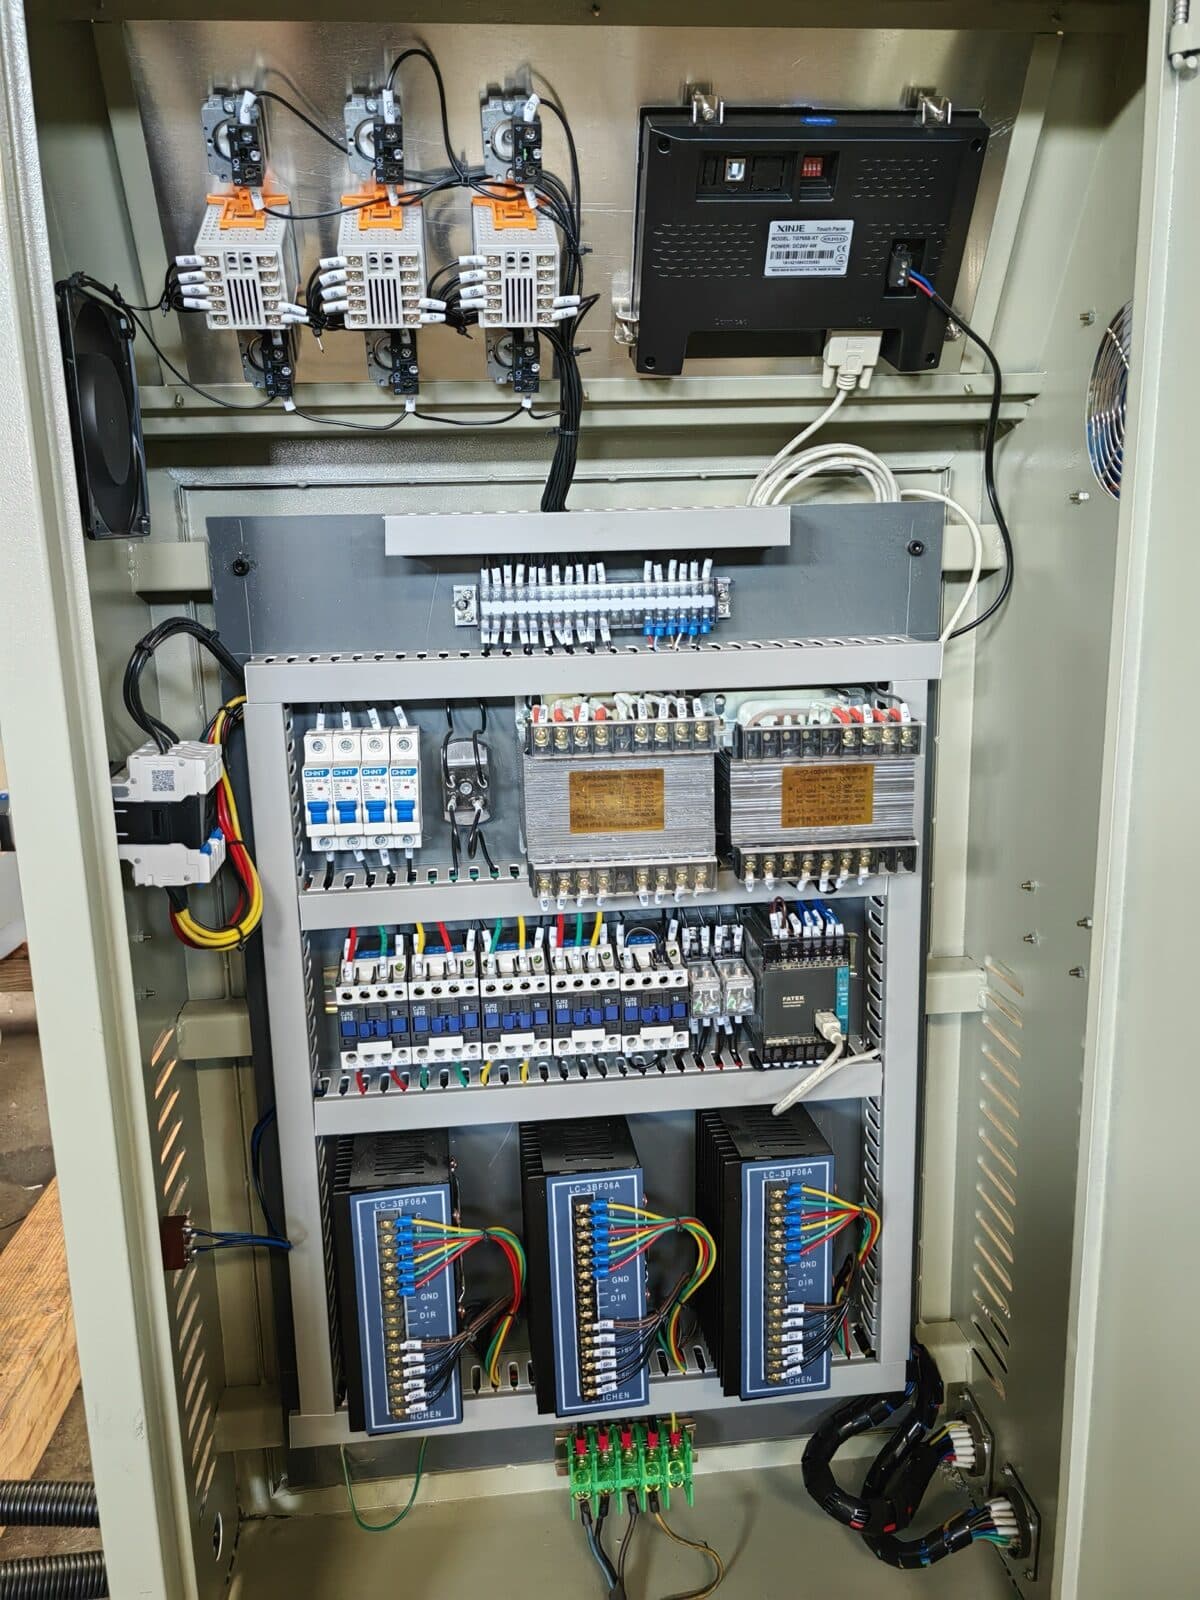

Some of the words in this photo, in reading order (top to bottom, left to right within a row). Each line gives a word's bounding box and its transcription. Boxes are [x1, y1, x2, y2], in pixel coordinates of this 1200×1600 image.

[777, 224, 806, 233] XINJE
[763, 1167, 813, 1179] LC-3BF06A
[569, 1181, 620, 1193] LC-3BF06A
[374, 1197, 427, 1210] LC-3BF06A
[800, 1260, 817, 1269] GND
[612, 1275, 629, 1284] GND
[798, 1278, 814, 1287] DIR
[420, 1292, 439, 1301] GND
[610, 1293, 627, 1302] DIR
[420, 1311, 437, 1319] DIR
[786, 1375, 812, 1385] CHEN
